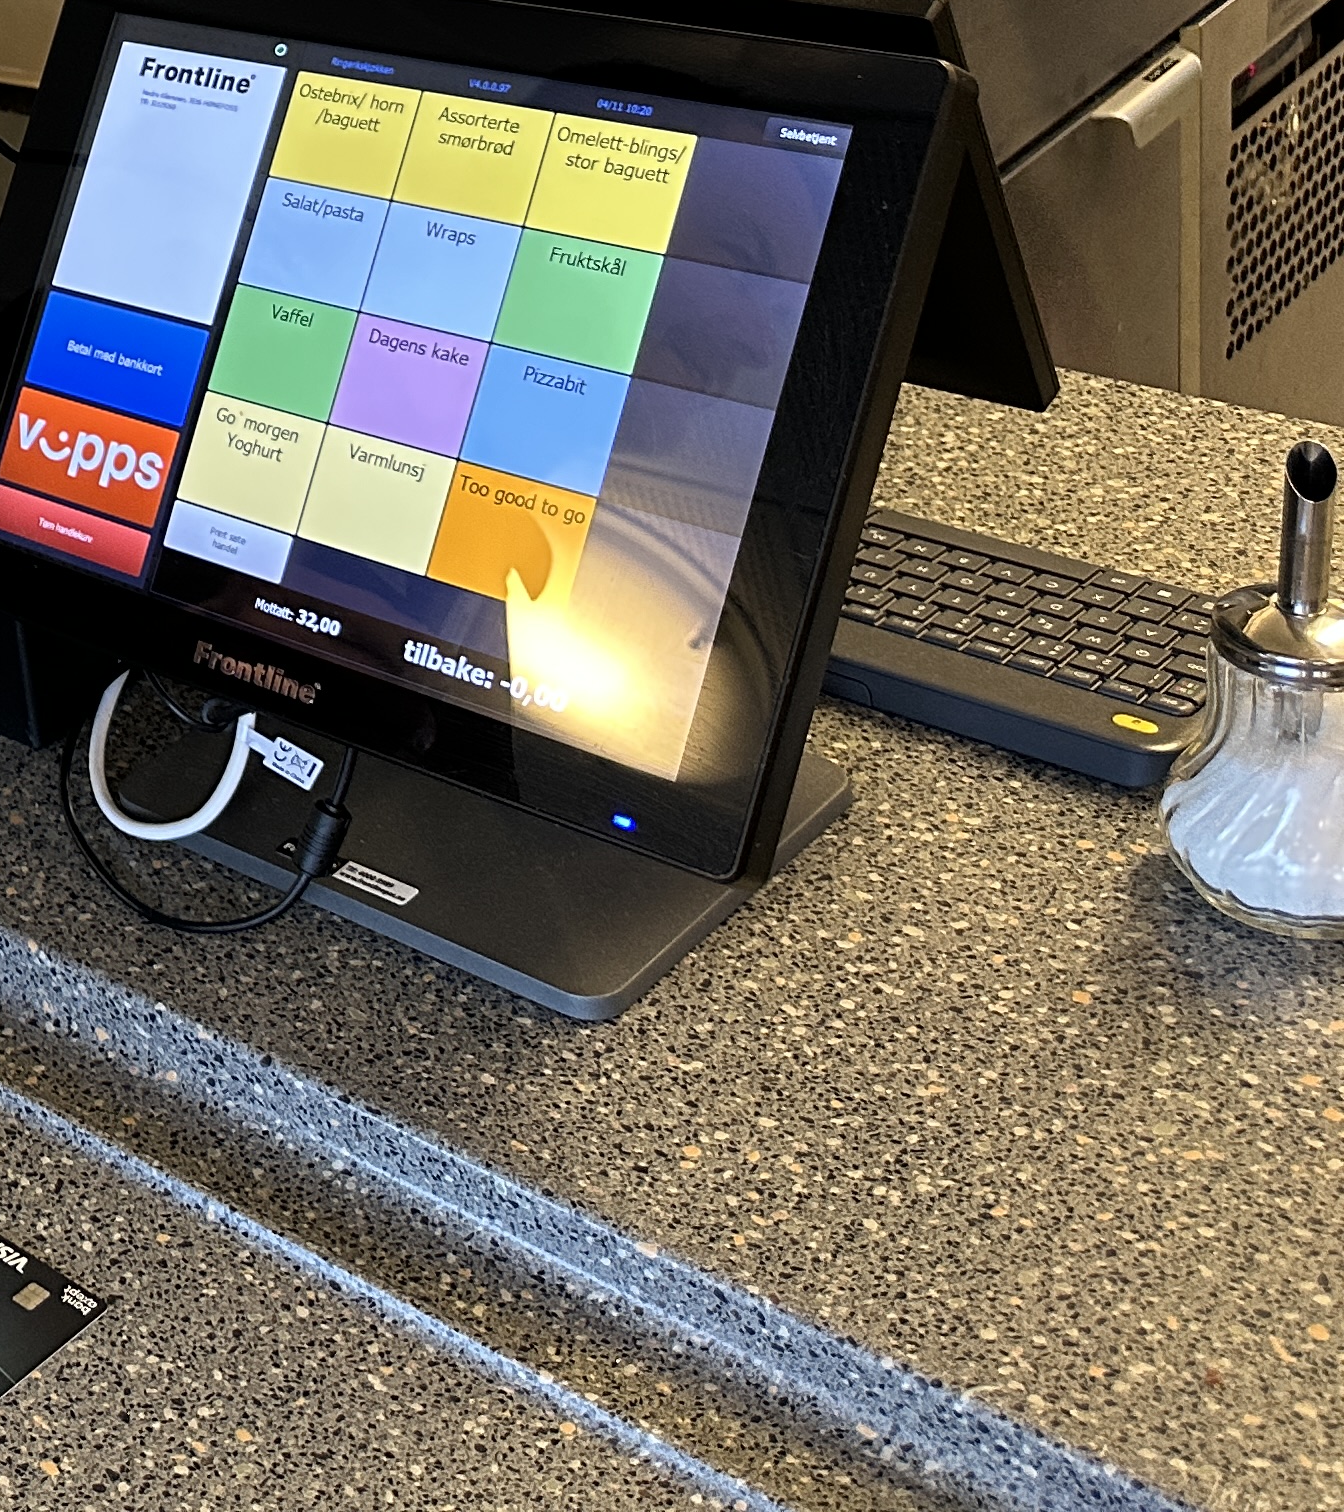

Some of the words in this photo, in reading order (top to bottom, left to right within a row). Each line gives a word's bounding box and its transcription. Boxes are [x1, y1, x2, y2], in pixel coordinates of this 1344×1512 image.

[139, 56, 253, 94] Frontline
[299, 83, 368, 108] Ostebrix/
[370, 91, 405, 114] horn
[315, 108, 381, 133] /baguett
[437, 106, 520, 134] Assorterte
[437, 131, 516, 157] smørbrød
[557, 126, 688, 165] Omelett-blings/
[565, 153, 600, 171] stor
[603, 156, 670, 185] baguett
[282, 192, 365, 223] Salat/pasta
[425, 220, 477, 247] Wraps
[549, 246, 627, 277] Fruktskål
[271, 303, 315, 328] Vaffel
[66, 339, 92, 357] Betal
[93, 348, 117, 364] med
[117, 352, 164, 377] bankkort
[368, 328, 427, 356] Dagens
[430, 342, 470, 366] kake
[522, 365, 588, 395] Pizzabit
[226, 431, 284, 463] Yoghurt
[349, 443, 426, 483] Varmlunsj
[459, 474, 490, 498] Too
[493, 487, 538, 511] good
[540, 498, 559, 517] to
[563, 507, 587, 525] go
[295, 608, 343, 637] 32,00
[193, 640, 318, 706] Frontline
[403, 639, 495, 690] tilbake:
[61, 1291, 92, 1317] bank
[63, 1284, 98, 1309] axept
